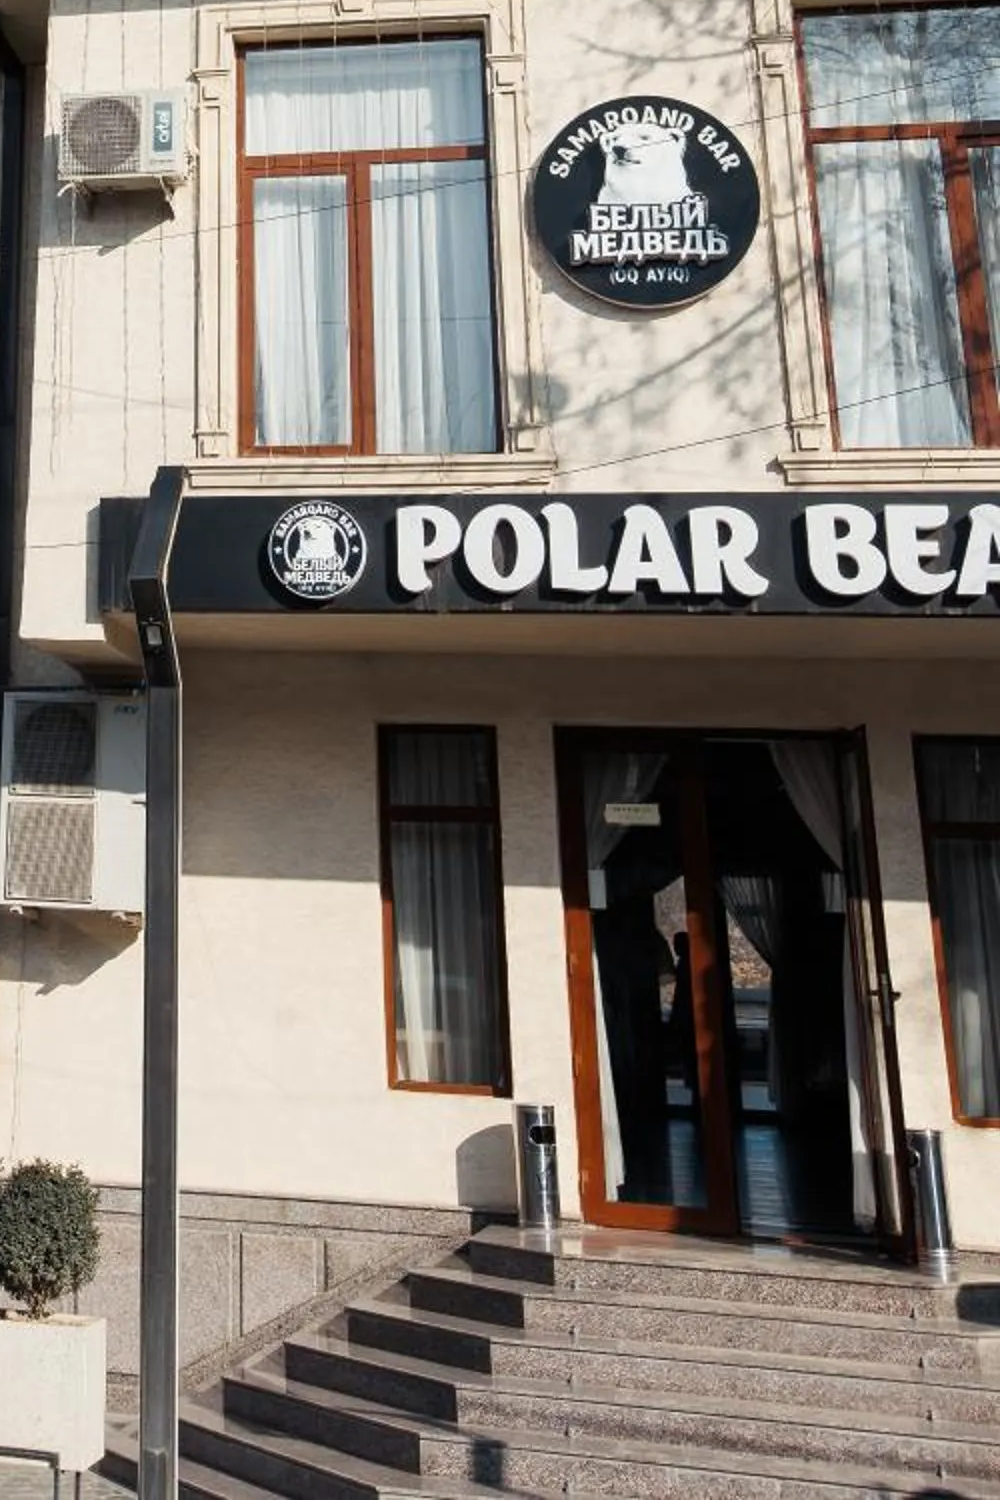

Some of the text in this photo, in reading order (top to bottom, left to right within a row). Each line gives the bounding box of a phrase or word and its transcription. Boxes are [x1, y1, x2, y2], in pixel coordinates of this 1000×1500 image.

[697, 125, 741, 173] BAR
[590, 192, 707, 231] БЕЛЫЙ
[571, 228, 729, 264] МЕДВЕДЬ
[293, 555, 343, 571] БЕЛЫЙ
[395, 503, 769, 596] POLAR
[284, 571, 351, 586] МЕДВЕДЬ
